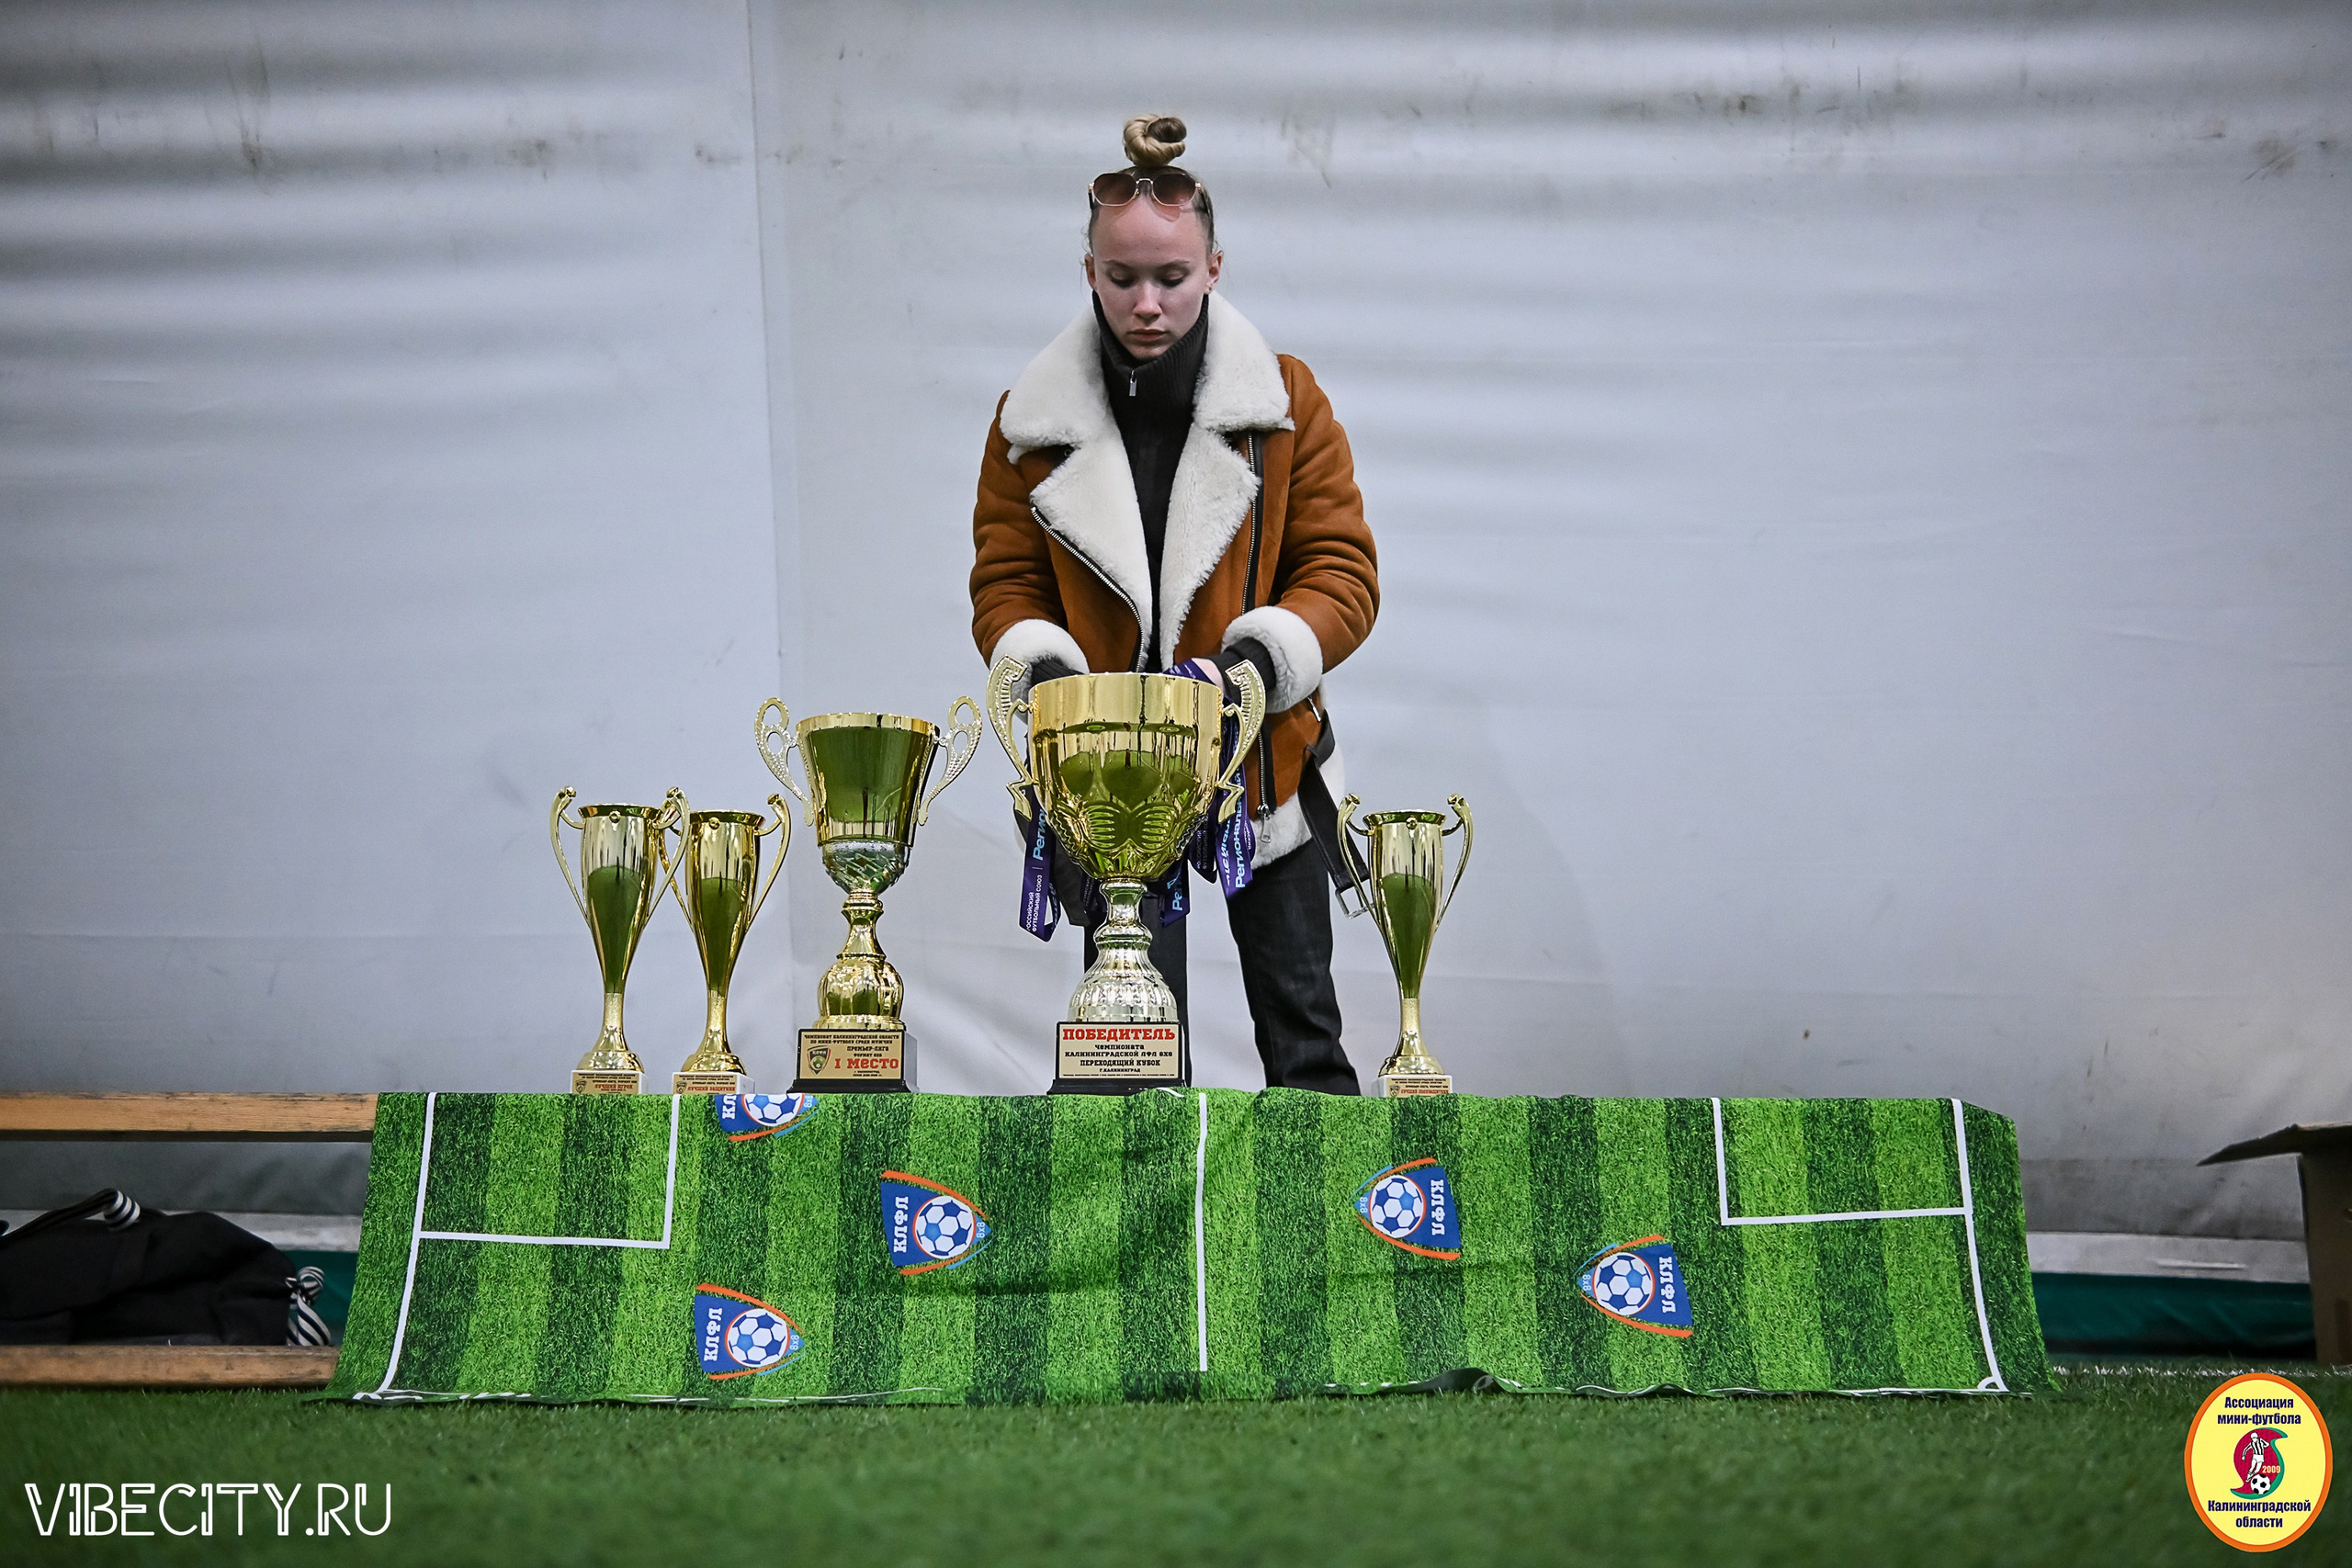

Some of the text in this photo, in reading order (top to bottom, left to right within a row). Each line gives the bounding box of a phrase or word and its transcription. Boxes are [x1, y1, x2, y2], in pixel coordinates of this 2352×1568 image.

[1032, 893, 1041, 932] ФУТБОЛЬНЫЙ
[1062, 1029, 1176, 1042] ПОБЕДИТЕЛЬ
[1065, 1050, 1139, 1058] КАЛИНИНГРАДСКОЙ
[1080, 1058, 1135, 1067] ПЕРЕХОДЯЩИЙ
[893, 1196, 909, 1253] КЛФЛ
[1430, 1179, 1445, 1235] КЛФЛ
[1658, 1257, 1676, 1314] КЛФЛ
[704, 1308, 723, 1361] КЛФЛ
